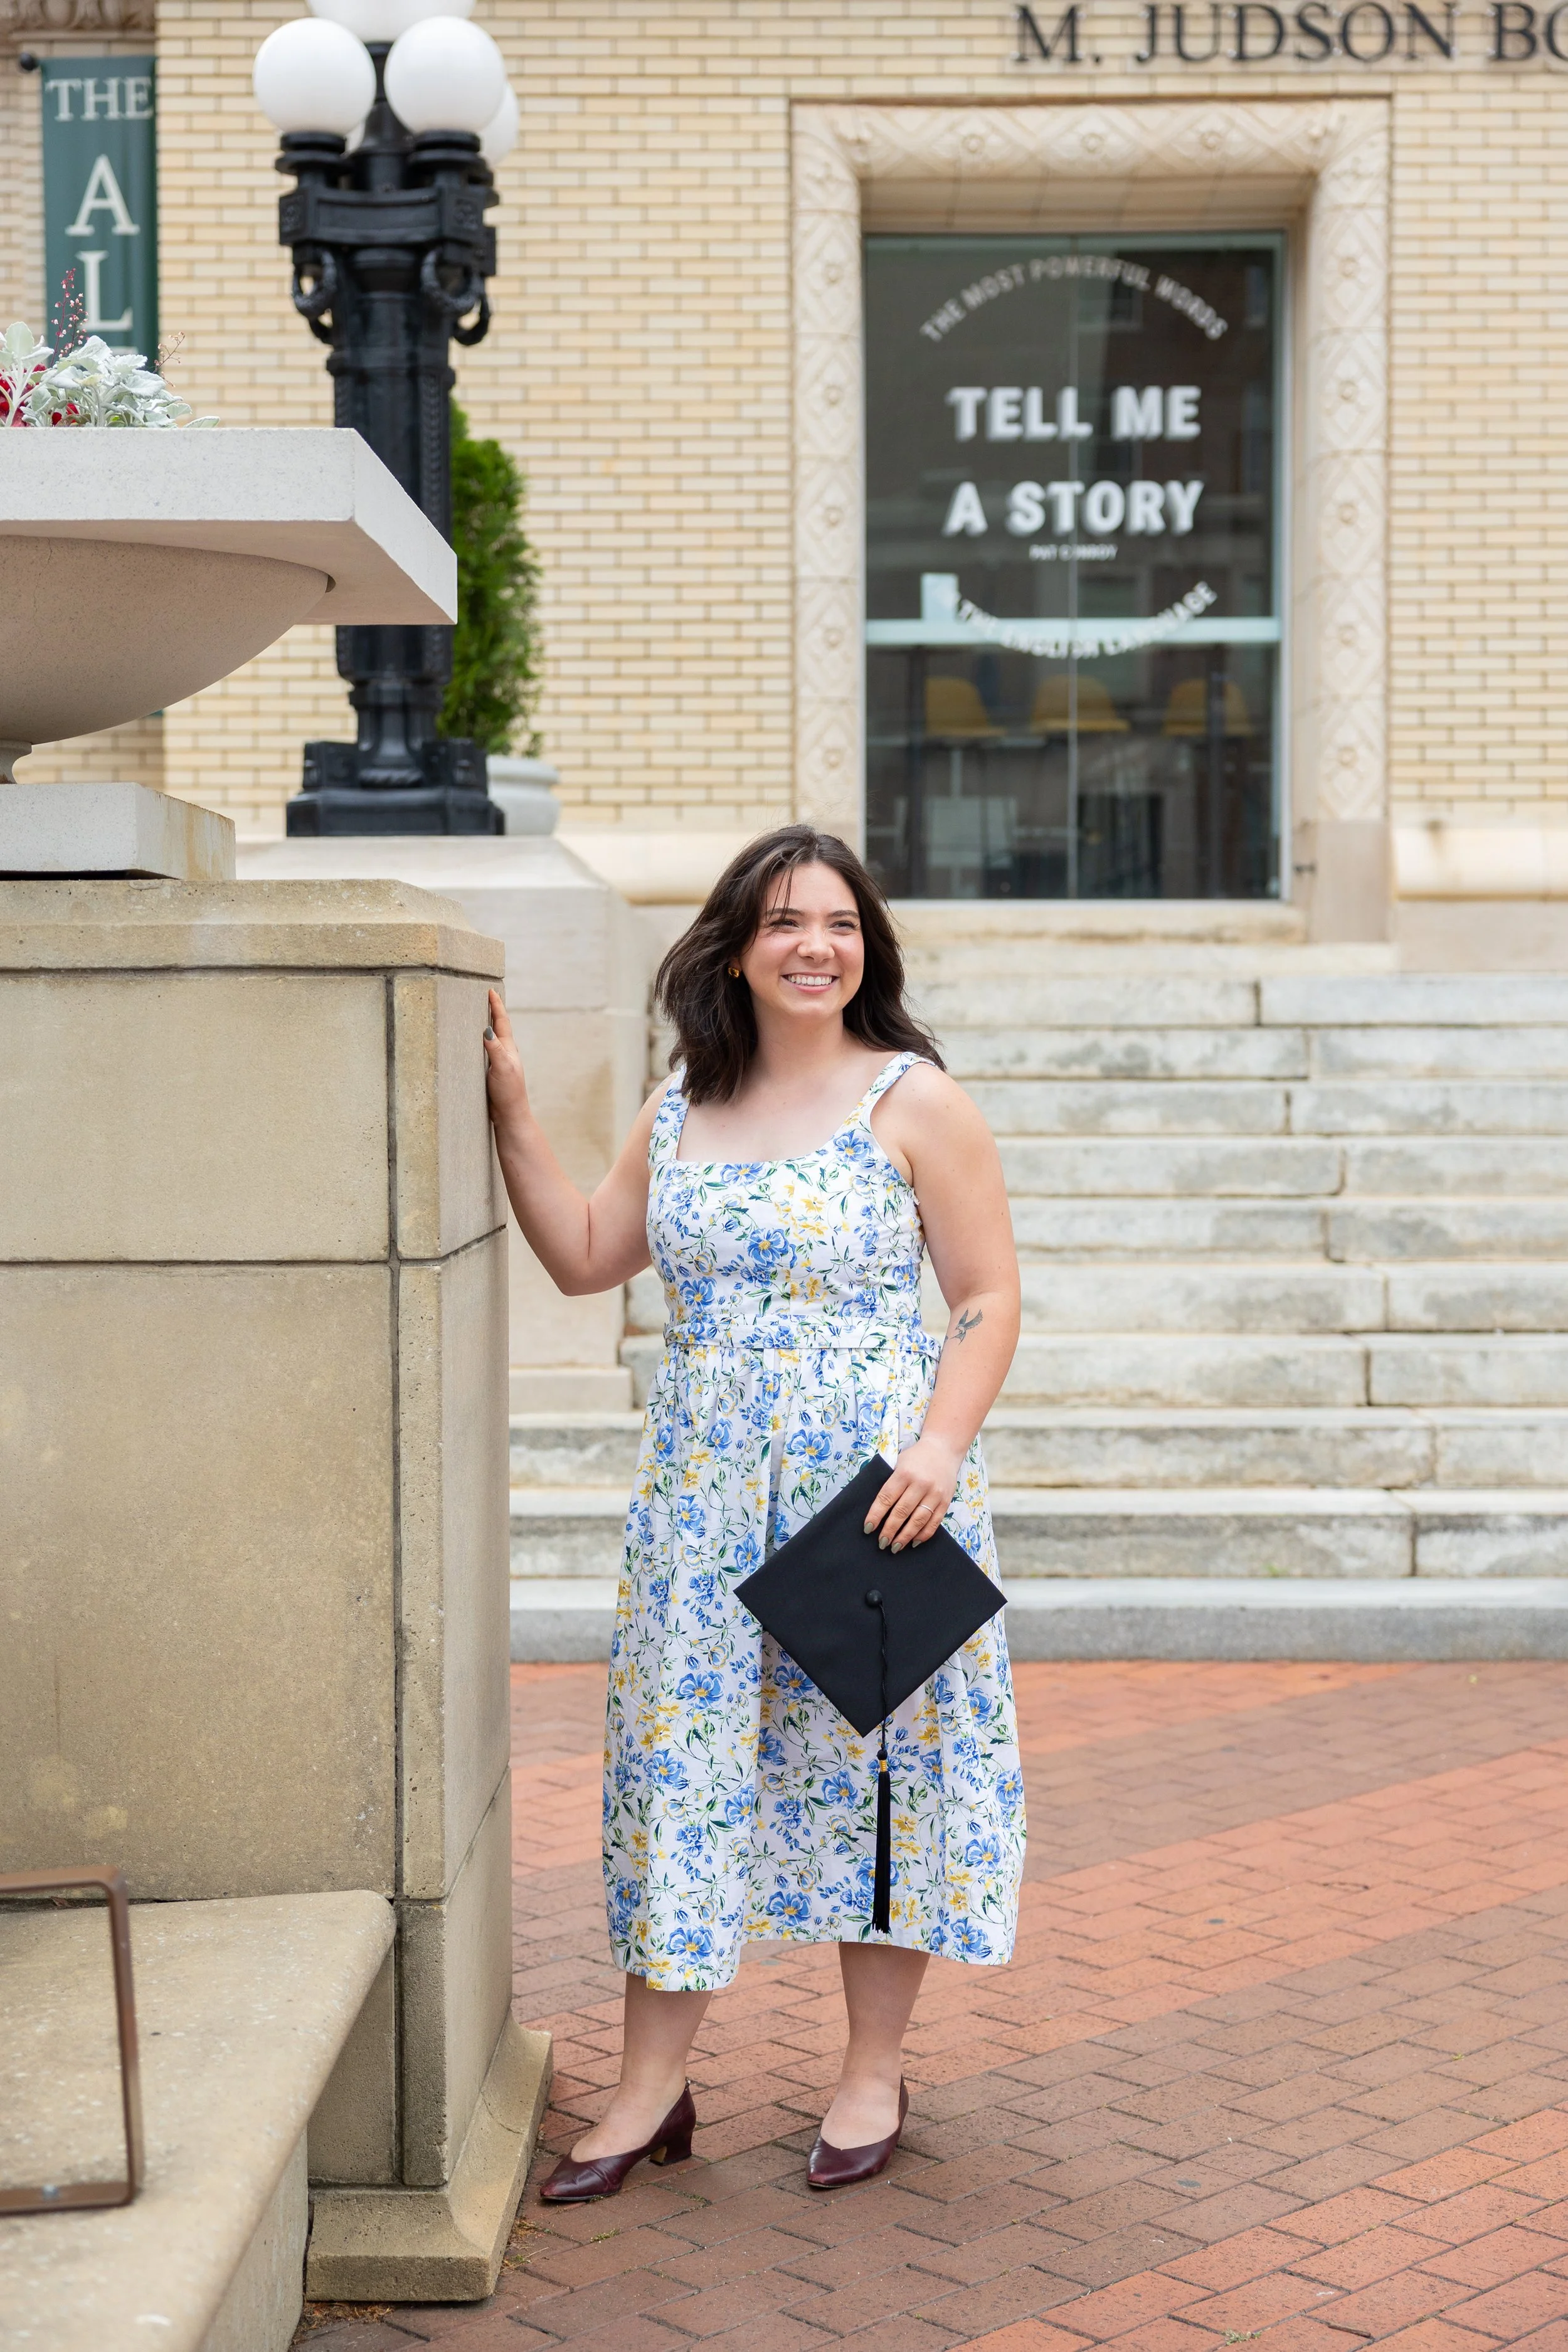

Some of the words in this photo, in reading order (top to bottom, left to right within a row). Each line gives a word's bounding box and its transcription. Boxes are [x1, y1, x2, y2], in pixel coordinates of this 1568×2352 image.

[1015, 4, 1102, 63] M.
[1135, 3, 1456, 63] JUDSON
[46, 76, 154, 121] THE
[65, 154, 139, 355] AL
[919, 298, 967, 343] THE
[960, 263, 1026, 311] MOST
[1029, 255, 1151, 292] POWERFUL
[1155, 273, 1229, 340] WORDS
[945, 385, 1094, 441] TELL
[1112, 384, 1202, 441] ME
[943, 481, 989, 537] A
[1006, 479, 1204, 538] STORY
